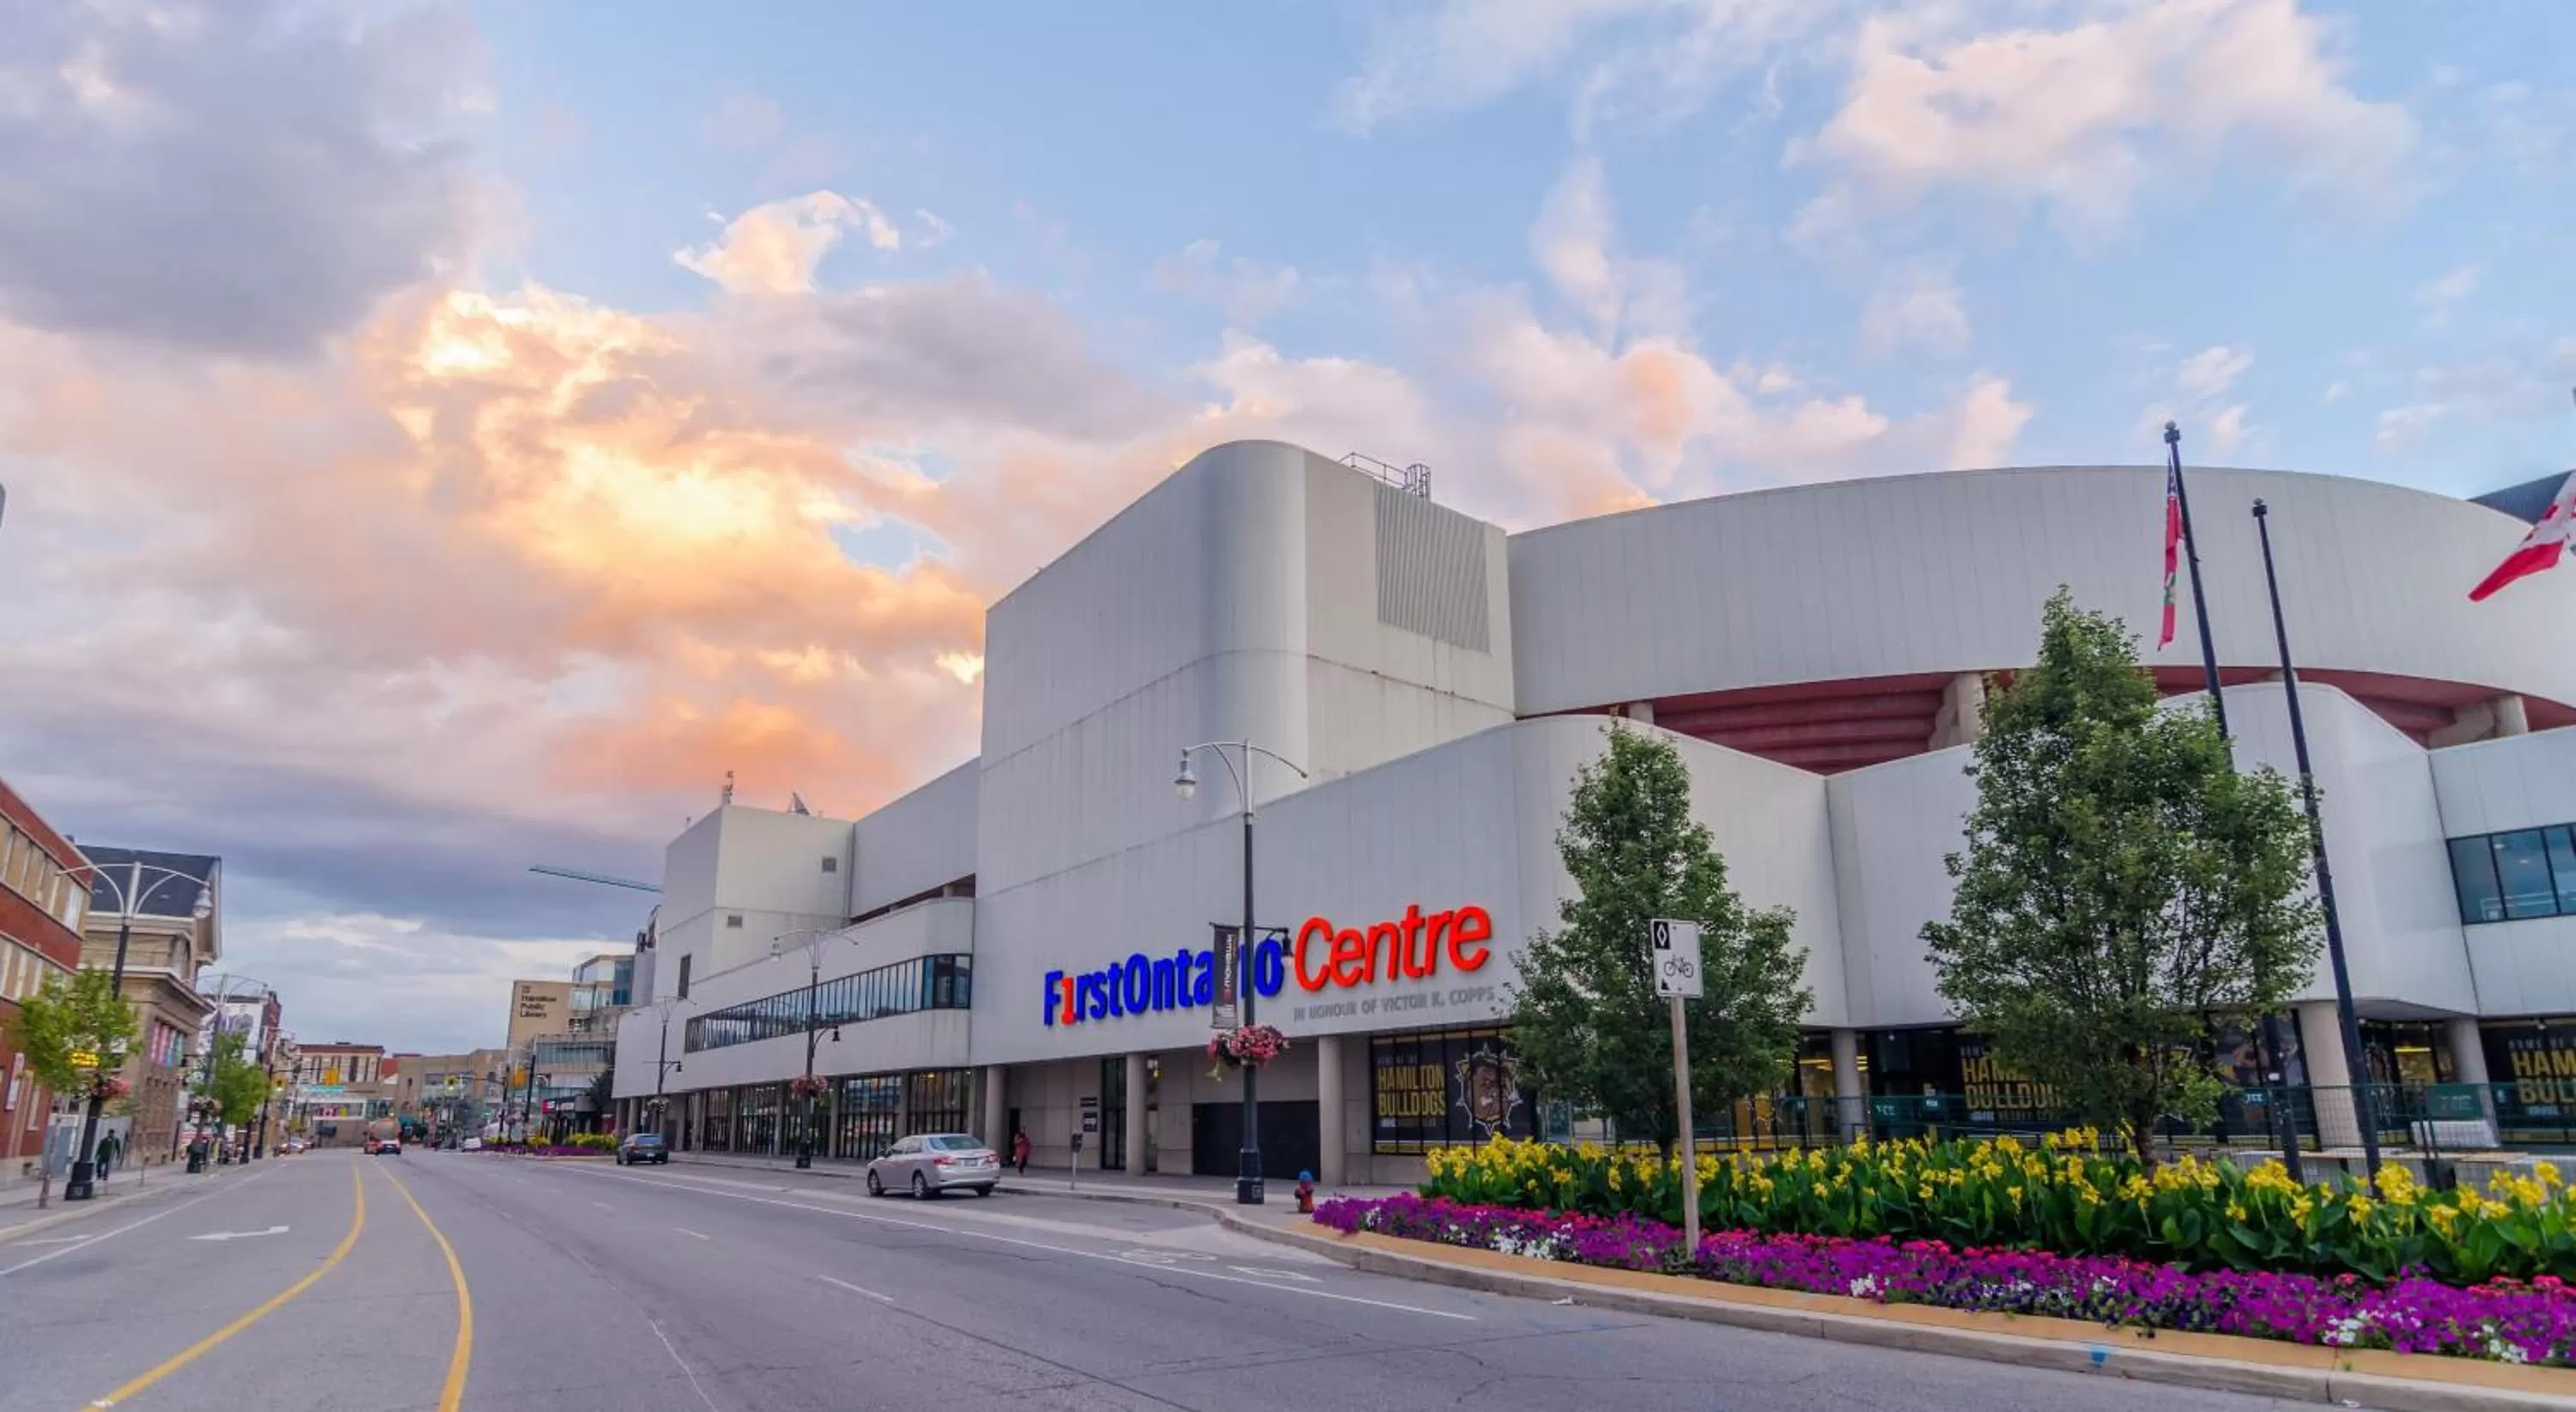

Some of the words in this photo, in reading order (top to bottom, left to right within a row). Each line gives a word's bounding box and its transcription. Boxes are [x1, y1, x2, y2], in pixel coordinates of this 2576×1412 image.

[1294, 904, 1492, 992] Centre
[1294, 1007, 1305, 1021] IN
[1309, 1001, 1357, 1019] HONOUR
[1361, 998, 1376, 1015] OF
[1381, 994, 1427, 1013] VICTOR
[1449, 986, 1496, 1005] COPPS
[1377, 1063, 1445, 1090] HAMILTON
[1377, 1090, 1446, 1116] BULLDOGS
